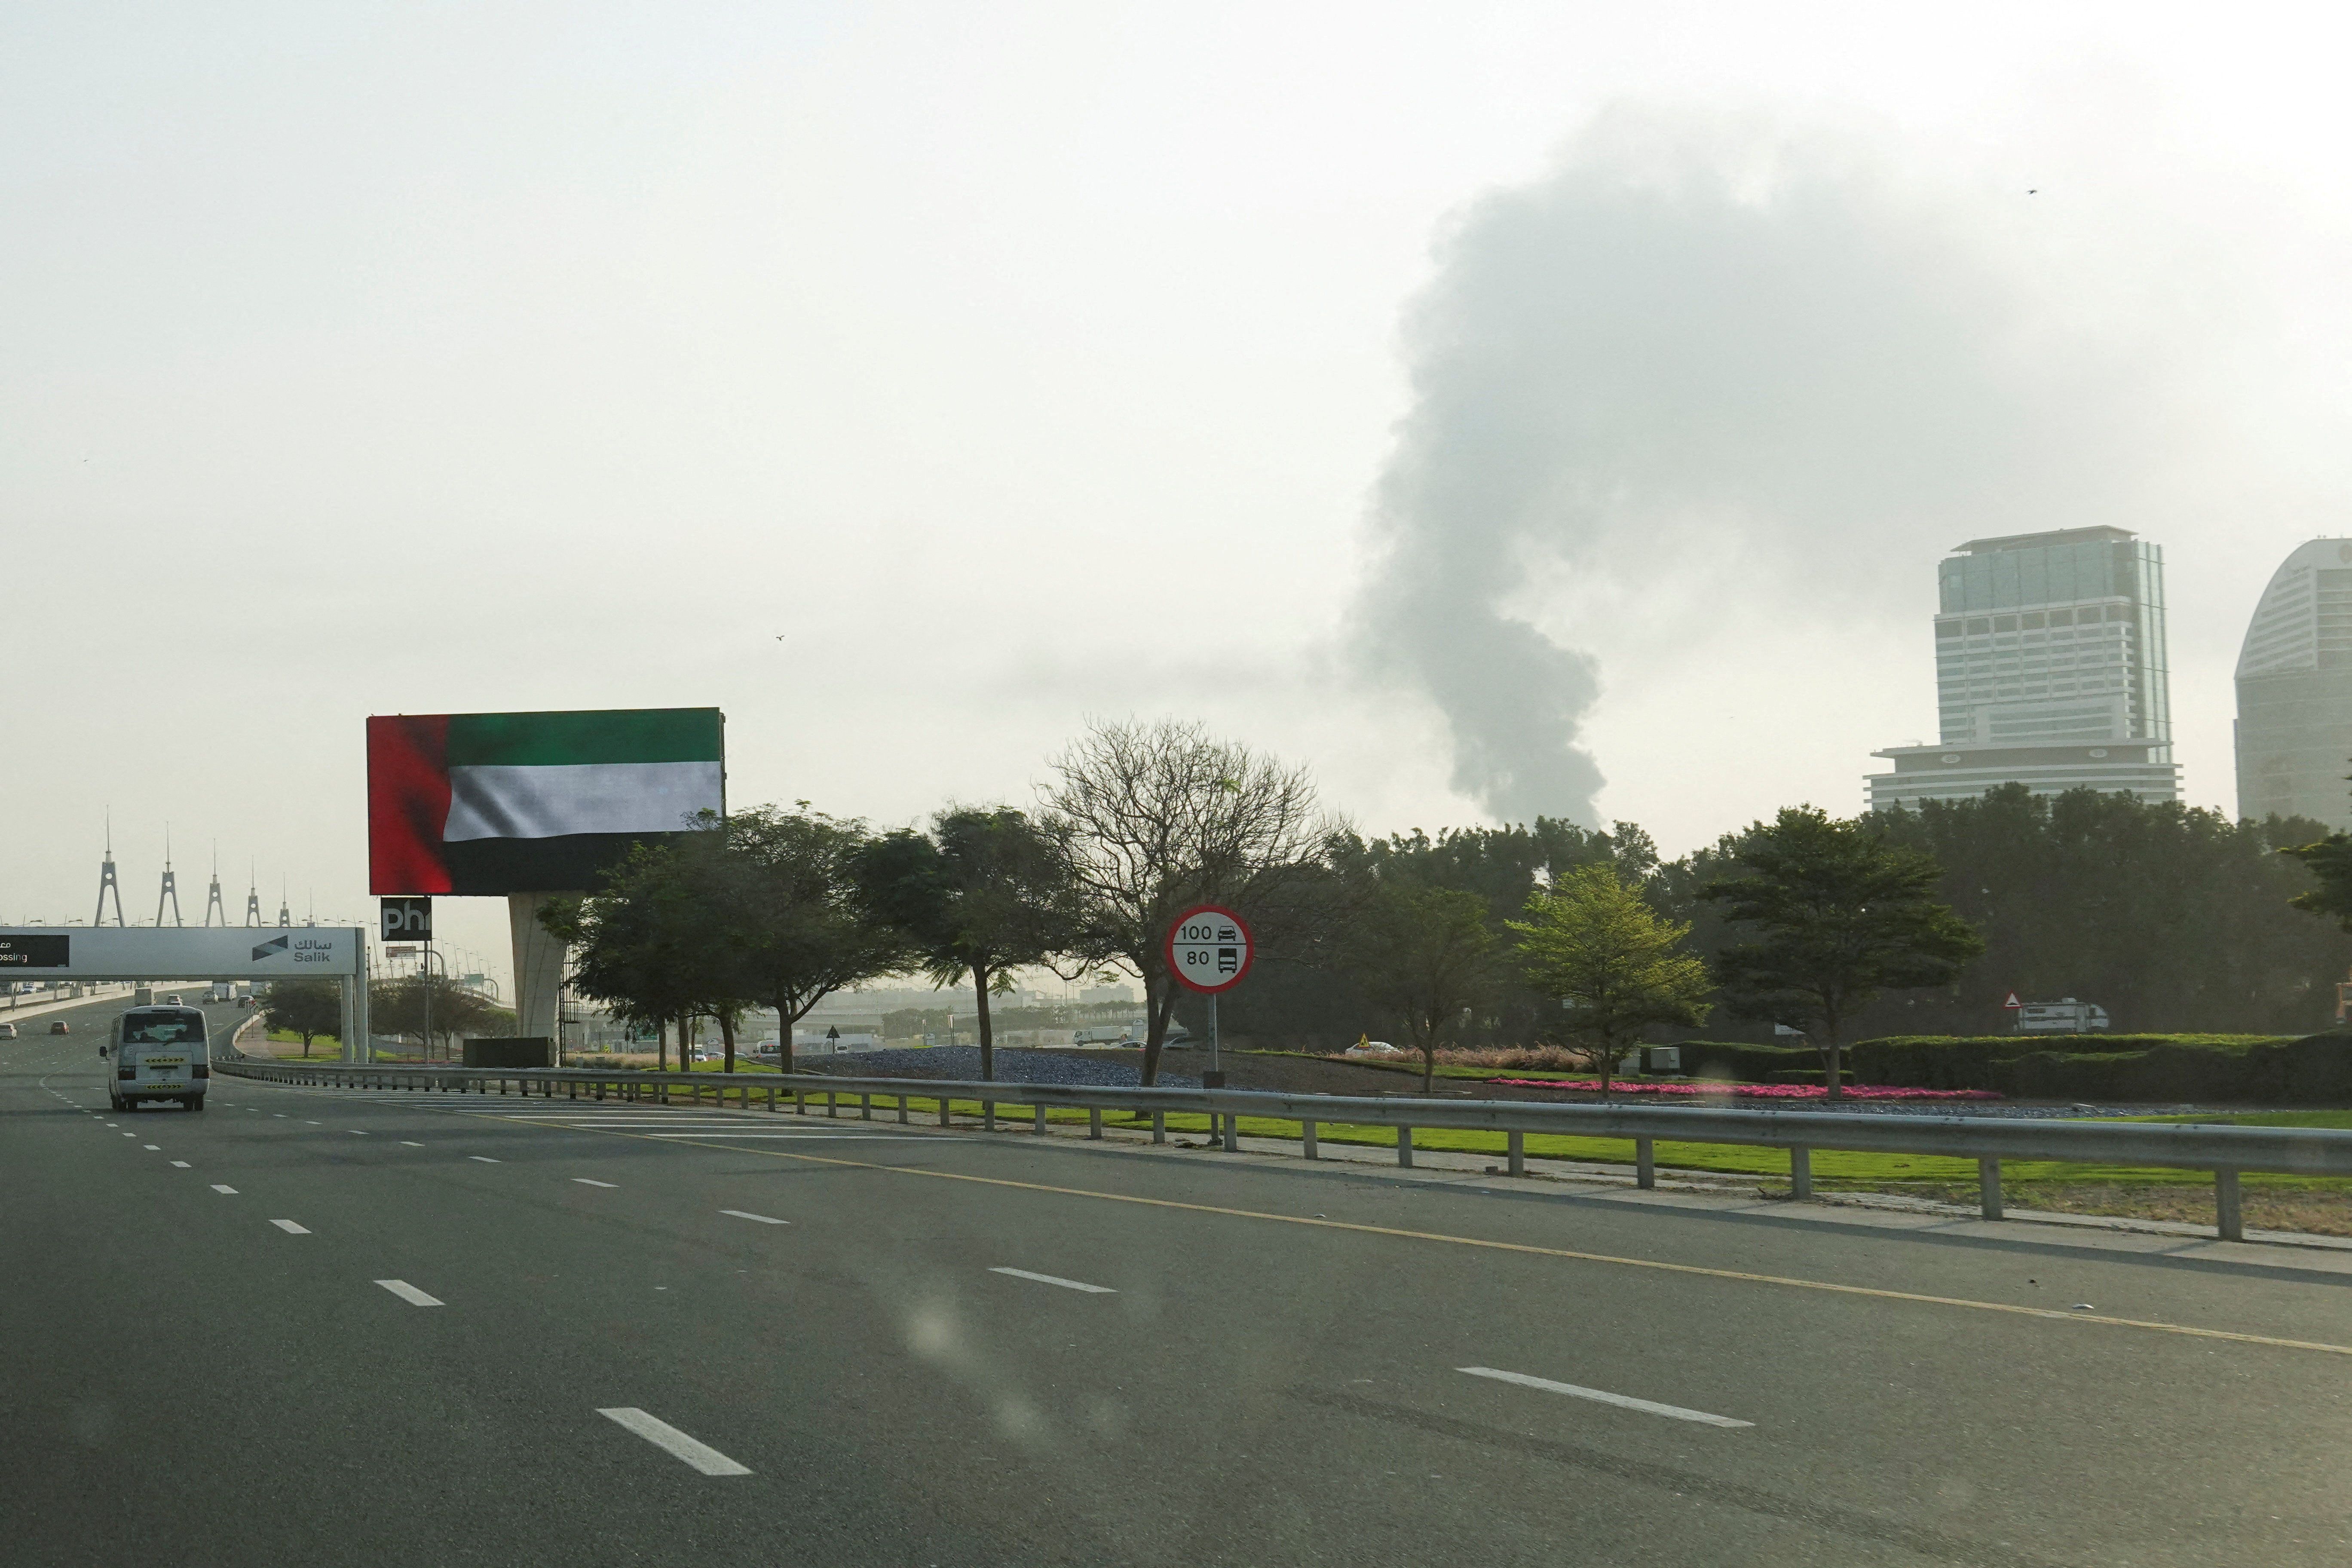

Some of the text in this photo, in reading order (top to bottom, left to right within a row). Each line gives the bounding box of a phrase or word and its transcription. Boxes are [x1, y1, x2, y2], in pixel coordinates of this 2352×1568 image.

[1182, 926, 1212, 940] 100
[294, 940, 331, 950] سالك
[294, 952, 330, 962] Salik
[1187, 951, 1209, 965] 80
